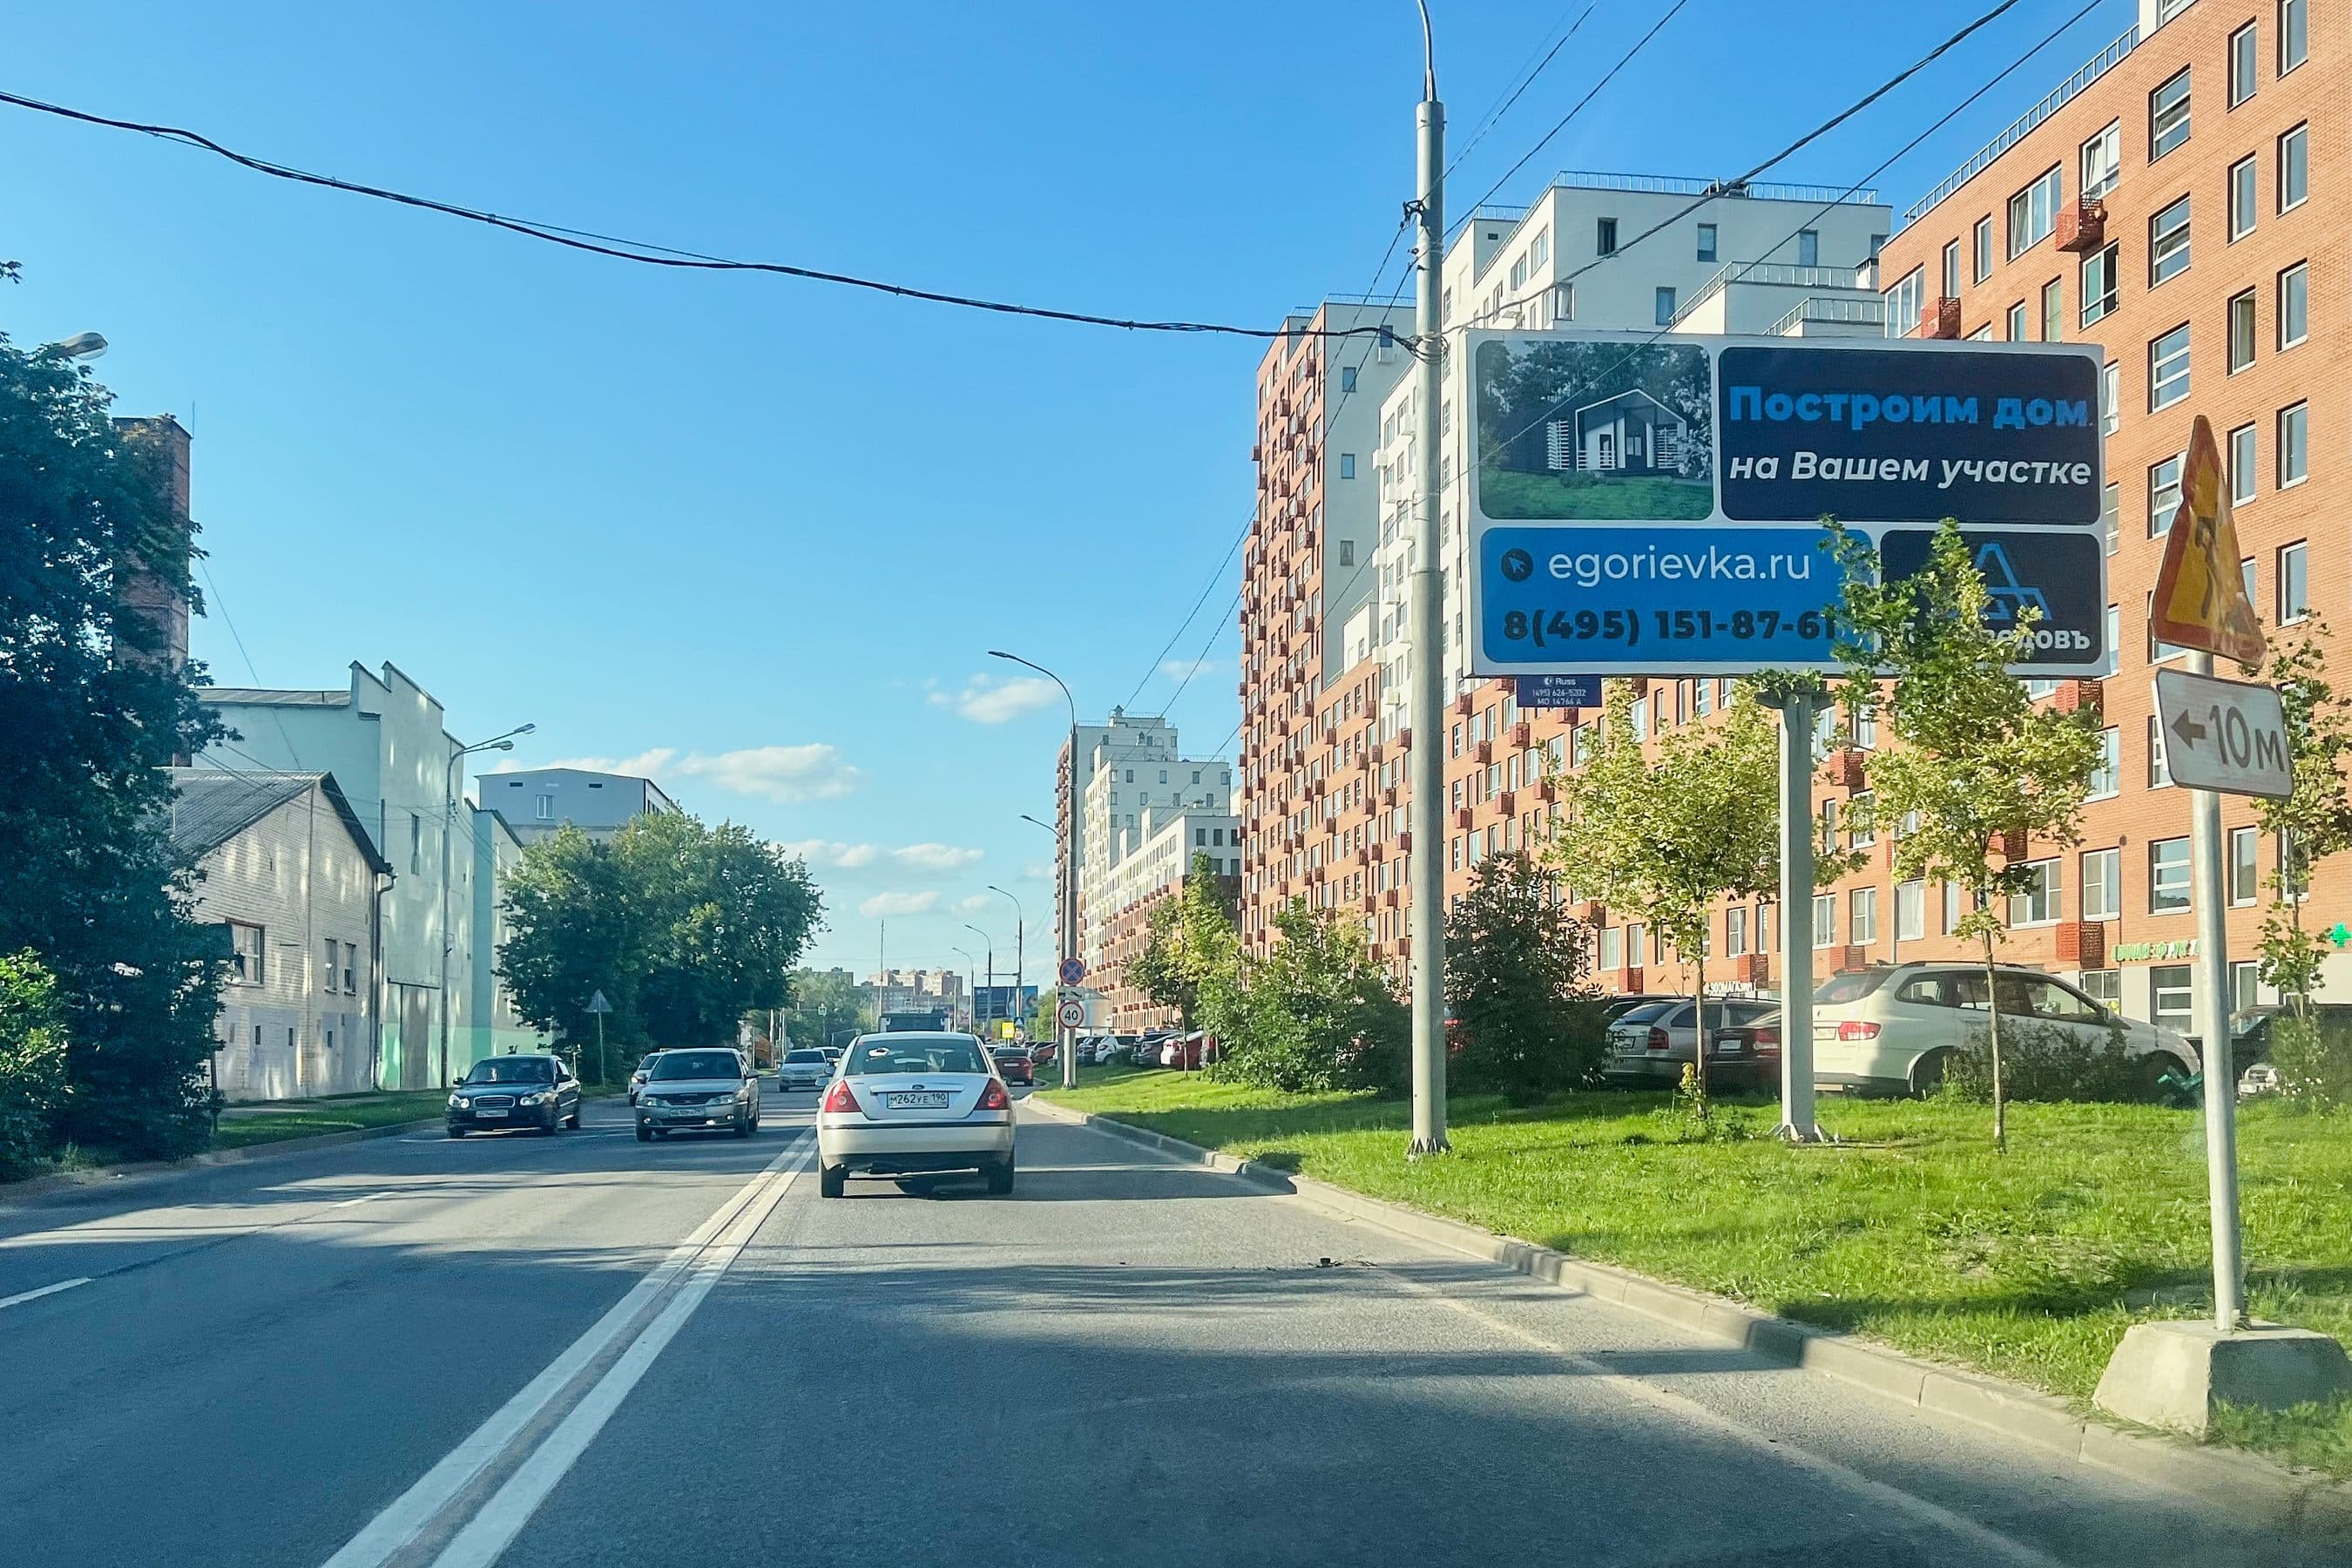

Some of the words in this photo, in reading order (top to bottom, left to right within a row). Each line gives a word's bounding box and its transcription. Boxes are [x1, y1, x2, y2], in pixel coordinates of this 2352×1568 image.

[1730, 386, 1978, 430] Построим
[1993, 397, 2087, 429] дом
[1730, 456, 1780, 480] на
[1791, 451, 1930, 481] Вашем
[1938, 458, 2092, 489] участке
[1549, 544, 1810, 587] egorievka.ru
[1504, 609, 1639, 647] 8(495)
[1555, 677, 1577, 686] Russ
[1064, 1010, 1078, 1021] 40
